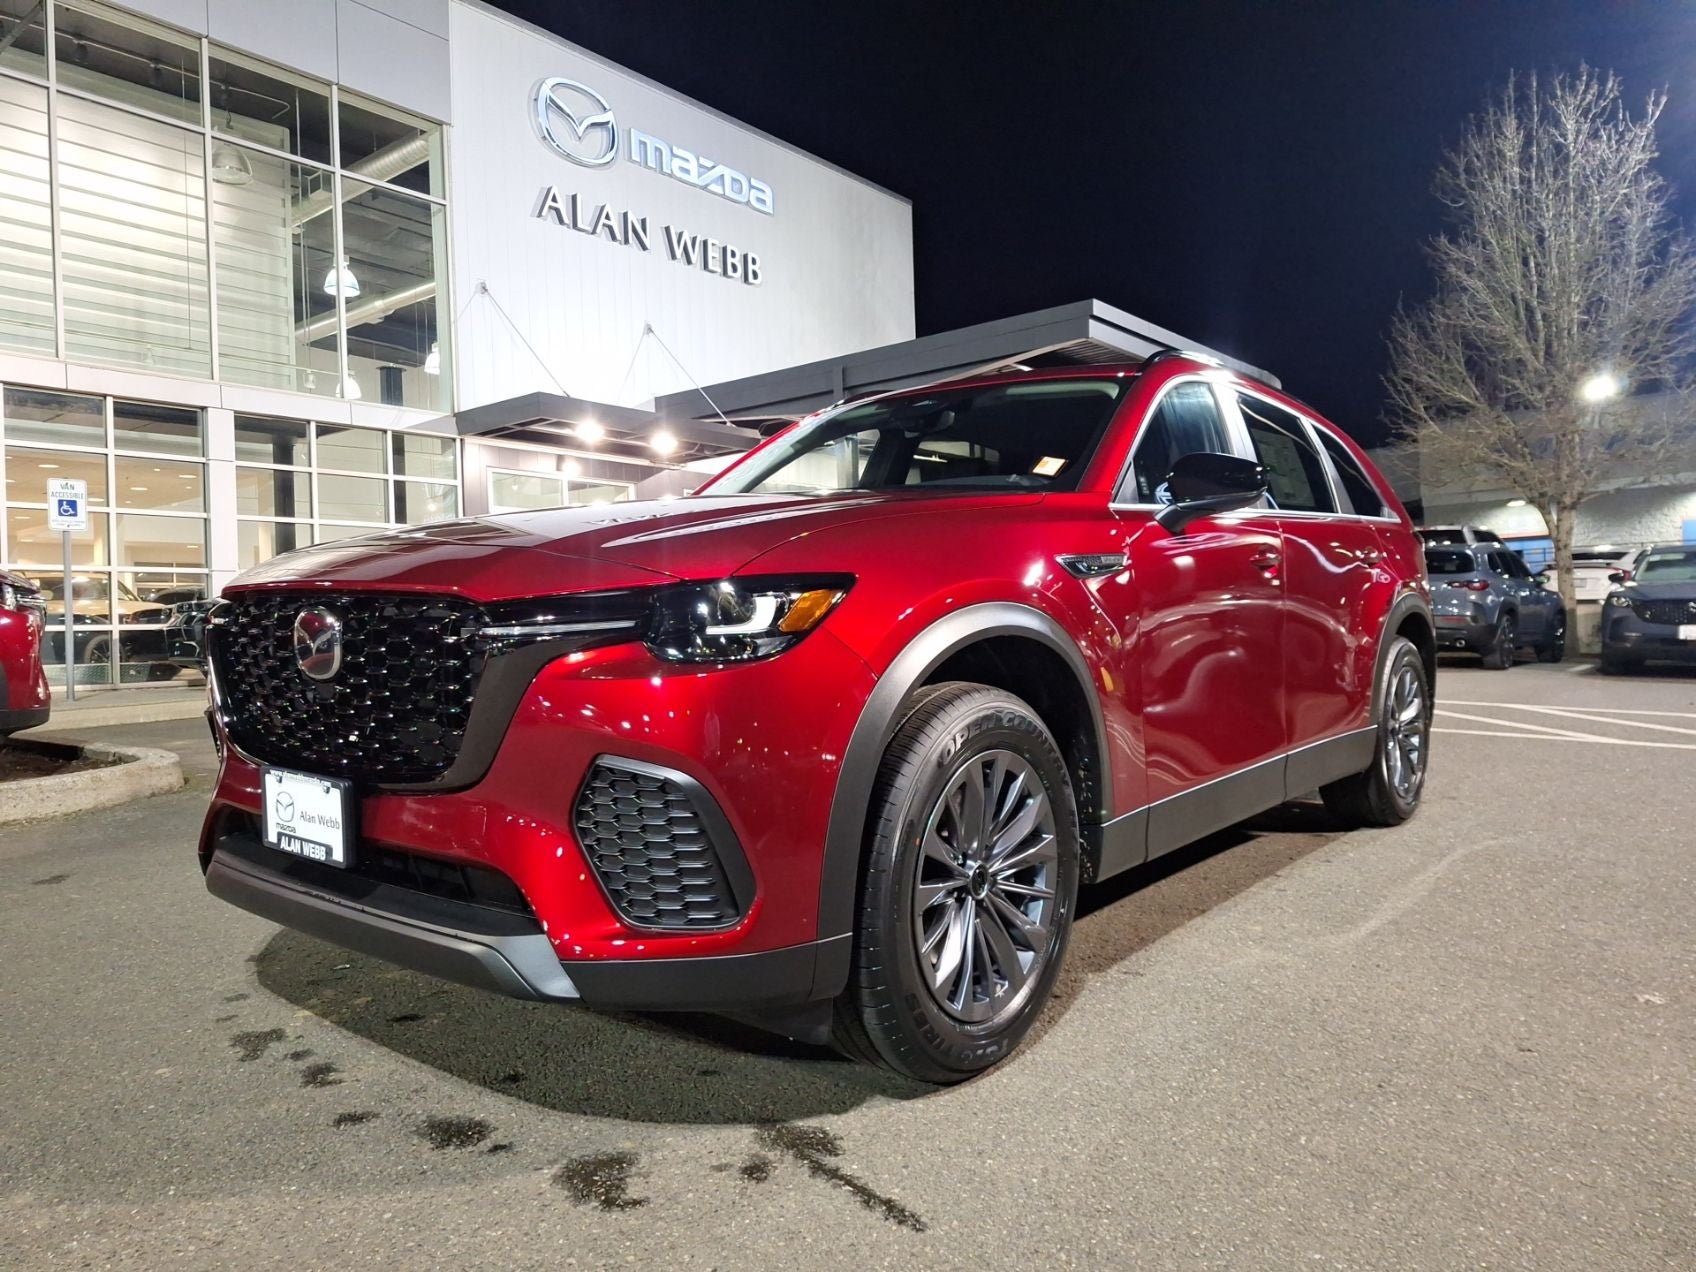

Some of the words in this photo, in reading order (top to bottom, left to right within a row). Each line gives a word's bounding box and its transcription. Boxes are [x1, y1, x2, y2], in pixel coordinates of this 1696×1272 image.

[537, 185, 650, 251] ALAN
[664, 225, 762, 285] WEBB
[51, 491, 84, 499] ACCESSIBLE
[60, 482, 75, 491] VAN
[300, 811, 316, 824] Alan
[317, 814, 341, 830] Webb
[280, 836, 301, 854] ALAN
[302, 841, 326, 860] WEBB
